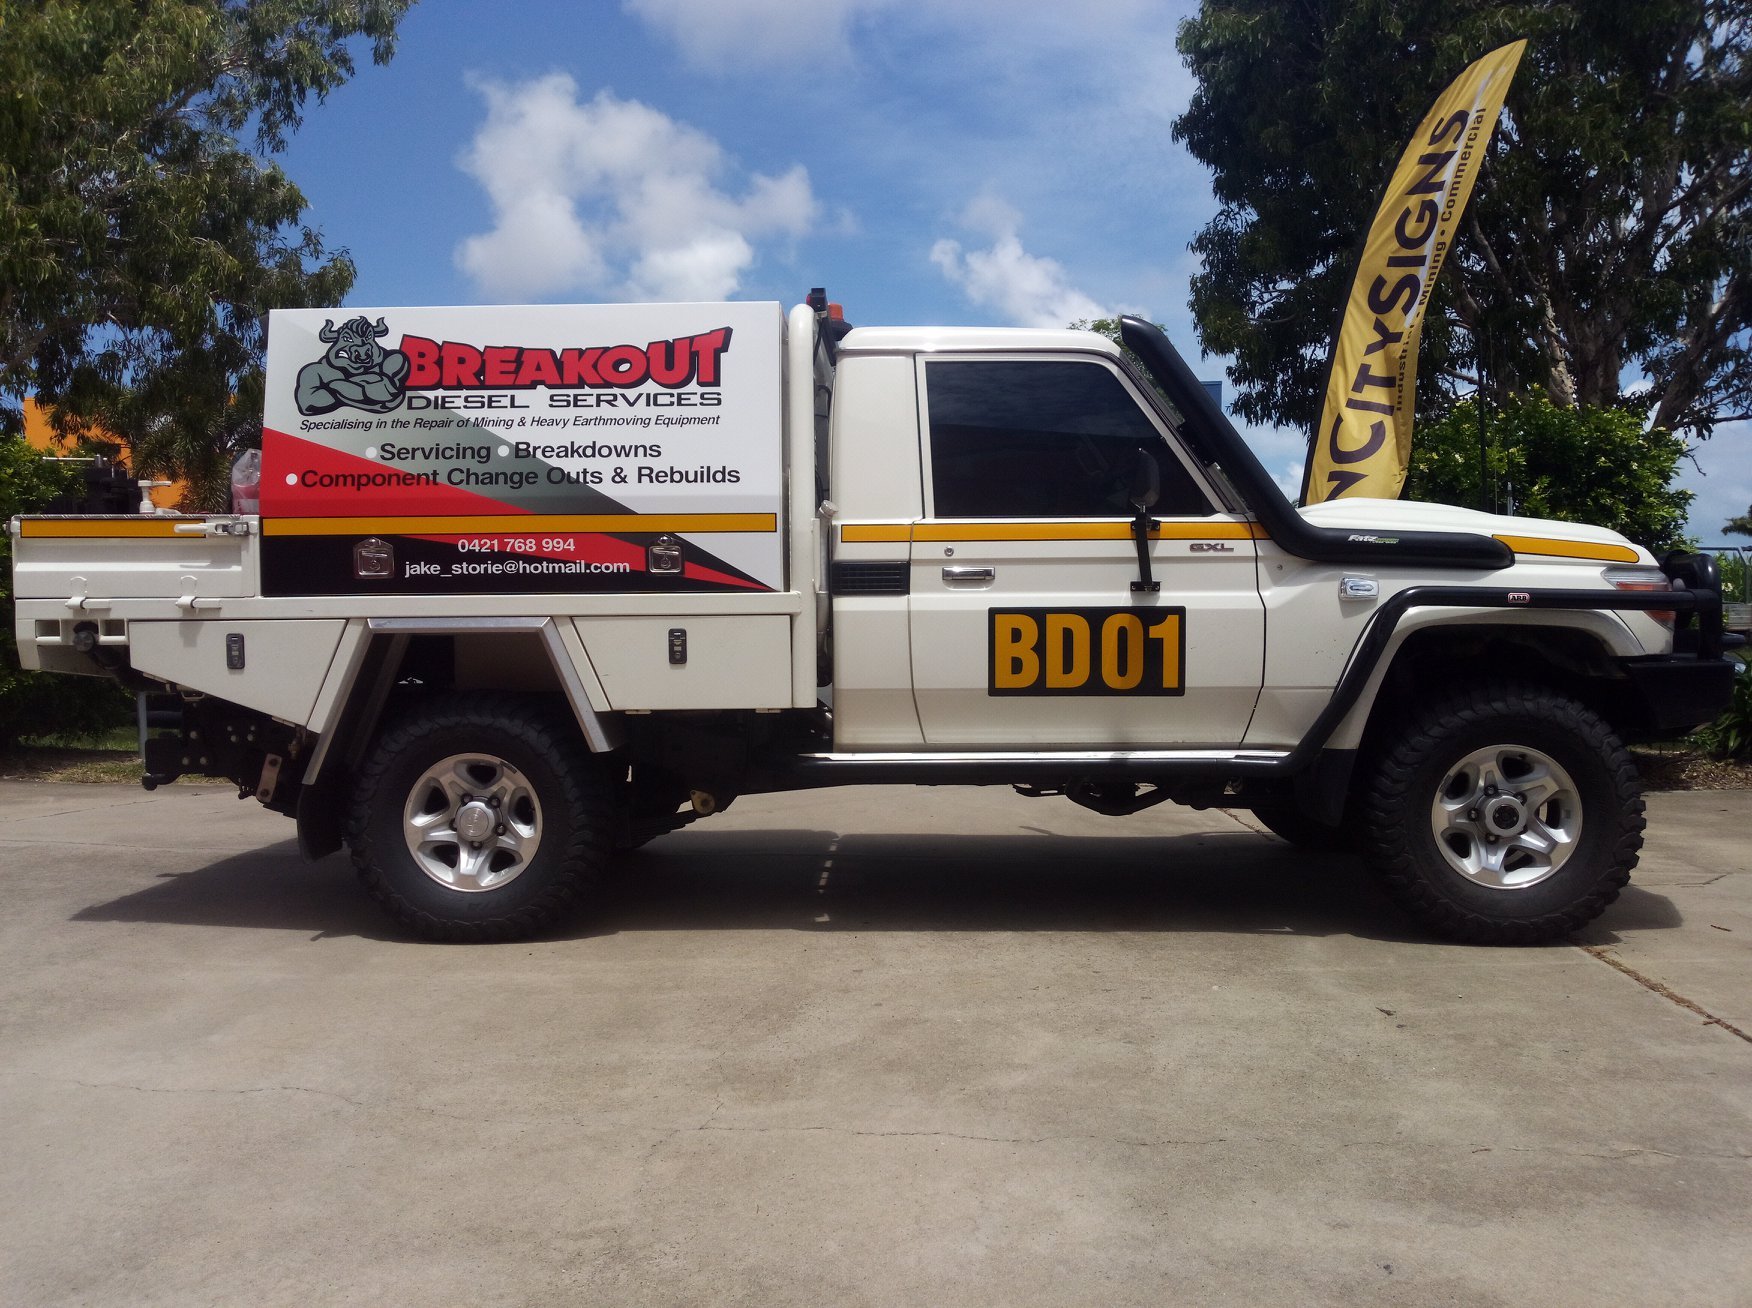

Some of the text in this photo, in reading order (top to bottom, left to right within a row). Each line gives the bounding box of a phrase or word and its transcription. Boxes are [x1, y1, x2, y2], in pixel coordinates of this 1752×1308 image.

[1418, 241, 1446, 305] Mining
[1441, 108, 1486, 222] Commercial
[399, 326, 734, 391] BREAKOUT
[406, 391, 722, 410] DIESEL SERVICES
[300, 414, 720, 432] Specialising in the Repair of Mining & Heavy Earthmoving Equipment
[380, 441, 662, 464] Servicing Breakdowns
[301, 465, 741, 491] Component Change Outs & Rebuilds
[458, 538, 576, 552] 0421 768 994
[1190, 543, 1234, 552] GXL
[405, 560, 630, 578] jake_storie@hotmail.com
